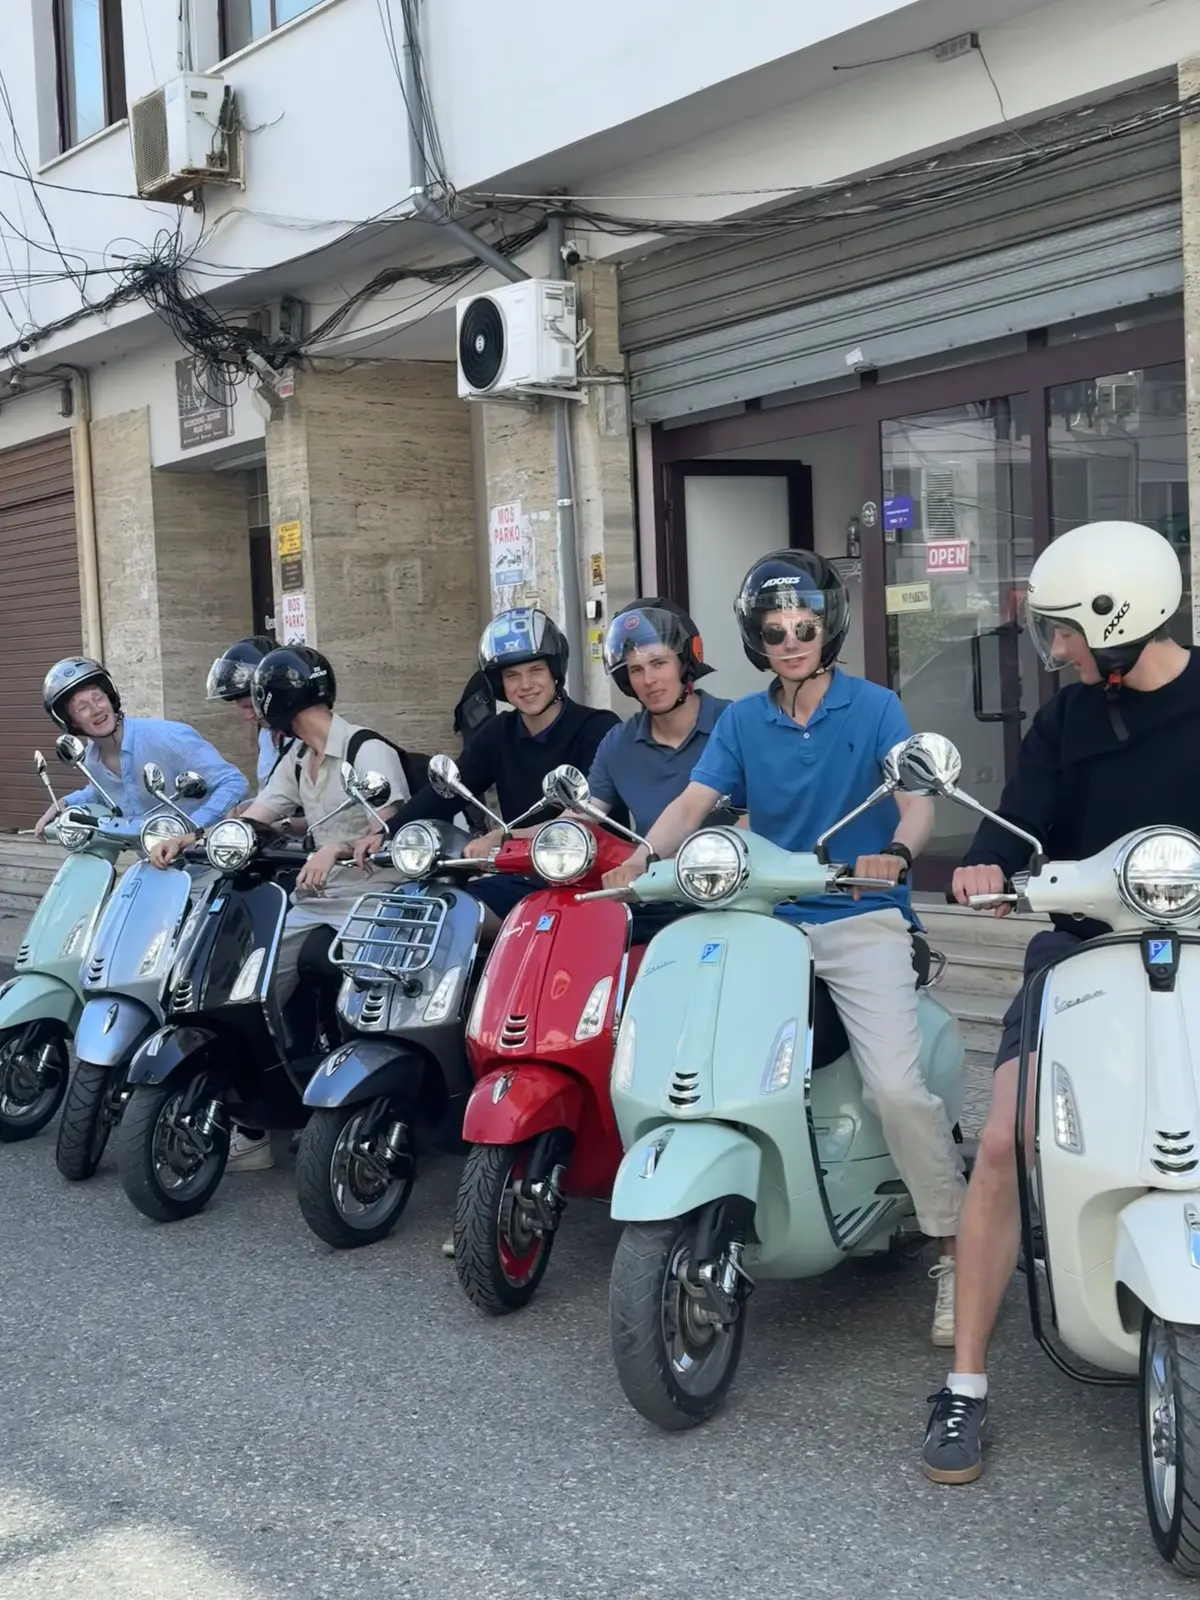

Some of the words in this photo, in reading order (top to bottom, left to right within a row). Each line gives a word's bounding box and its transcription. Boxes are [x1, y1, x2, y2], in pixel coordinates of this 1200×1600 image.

[494, 525, 520, 544] PARKO
[929, 547, 966, 566] OPEN
[284, 614, 305, 629] PARKO
[1103, 600, 1131, 642] AXXIS
